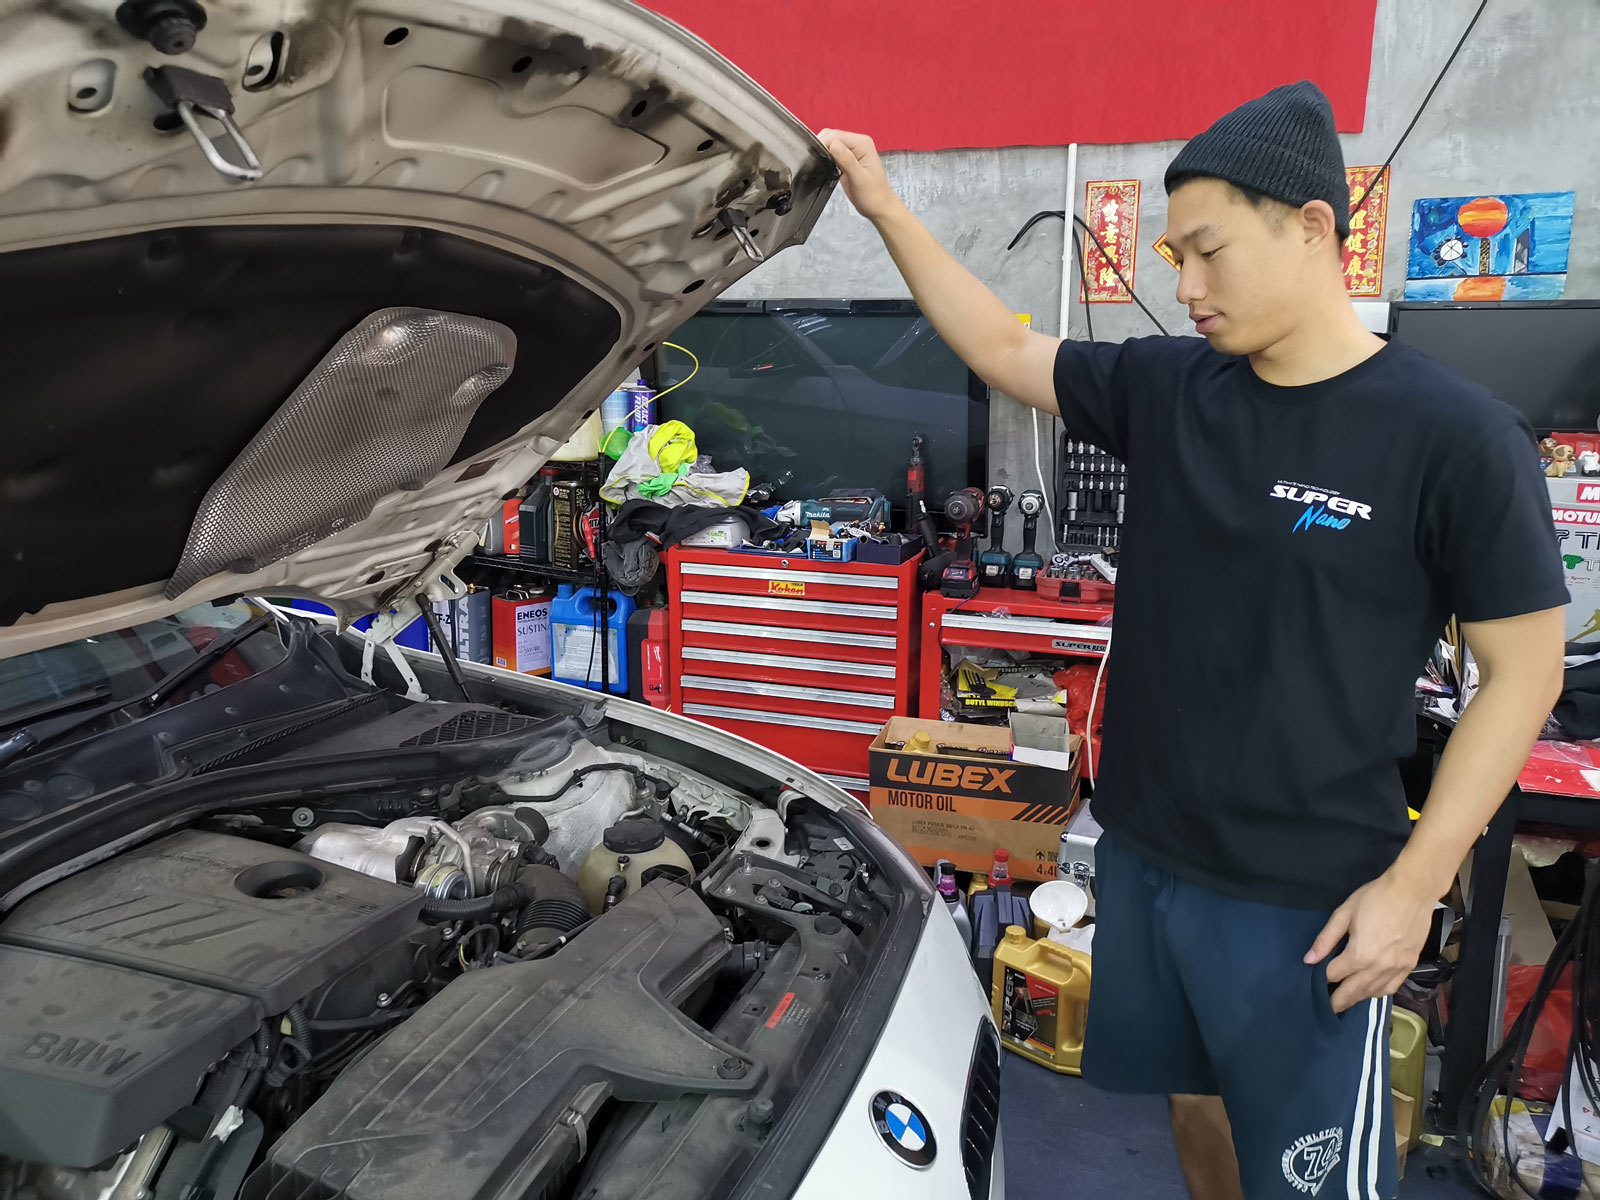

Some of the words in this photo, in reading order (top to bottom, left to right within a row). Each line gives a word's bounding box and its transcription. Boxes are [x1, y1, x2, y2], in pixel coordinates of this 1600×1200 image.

[634, 395, 642, 423] FLUID
[1269, 484, 1372, 520] SUPER
[1291, 504, 1351, 534] Nano
[458, 596, 470, 661] ULTRA
[517, 607, 548, 621] ENEOS
[1055, 641, 1091, 650] SUPER
[965, 699, 986, 707] BUTYL
[886, 758, 1017, 794] LUBEX
[888, 790, 933, 809] MOTOR
[936, 796, 957, 812] OIL
[23, 1032, 142, 1075] BMW
